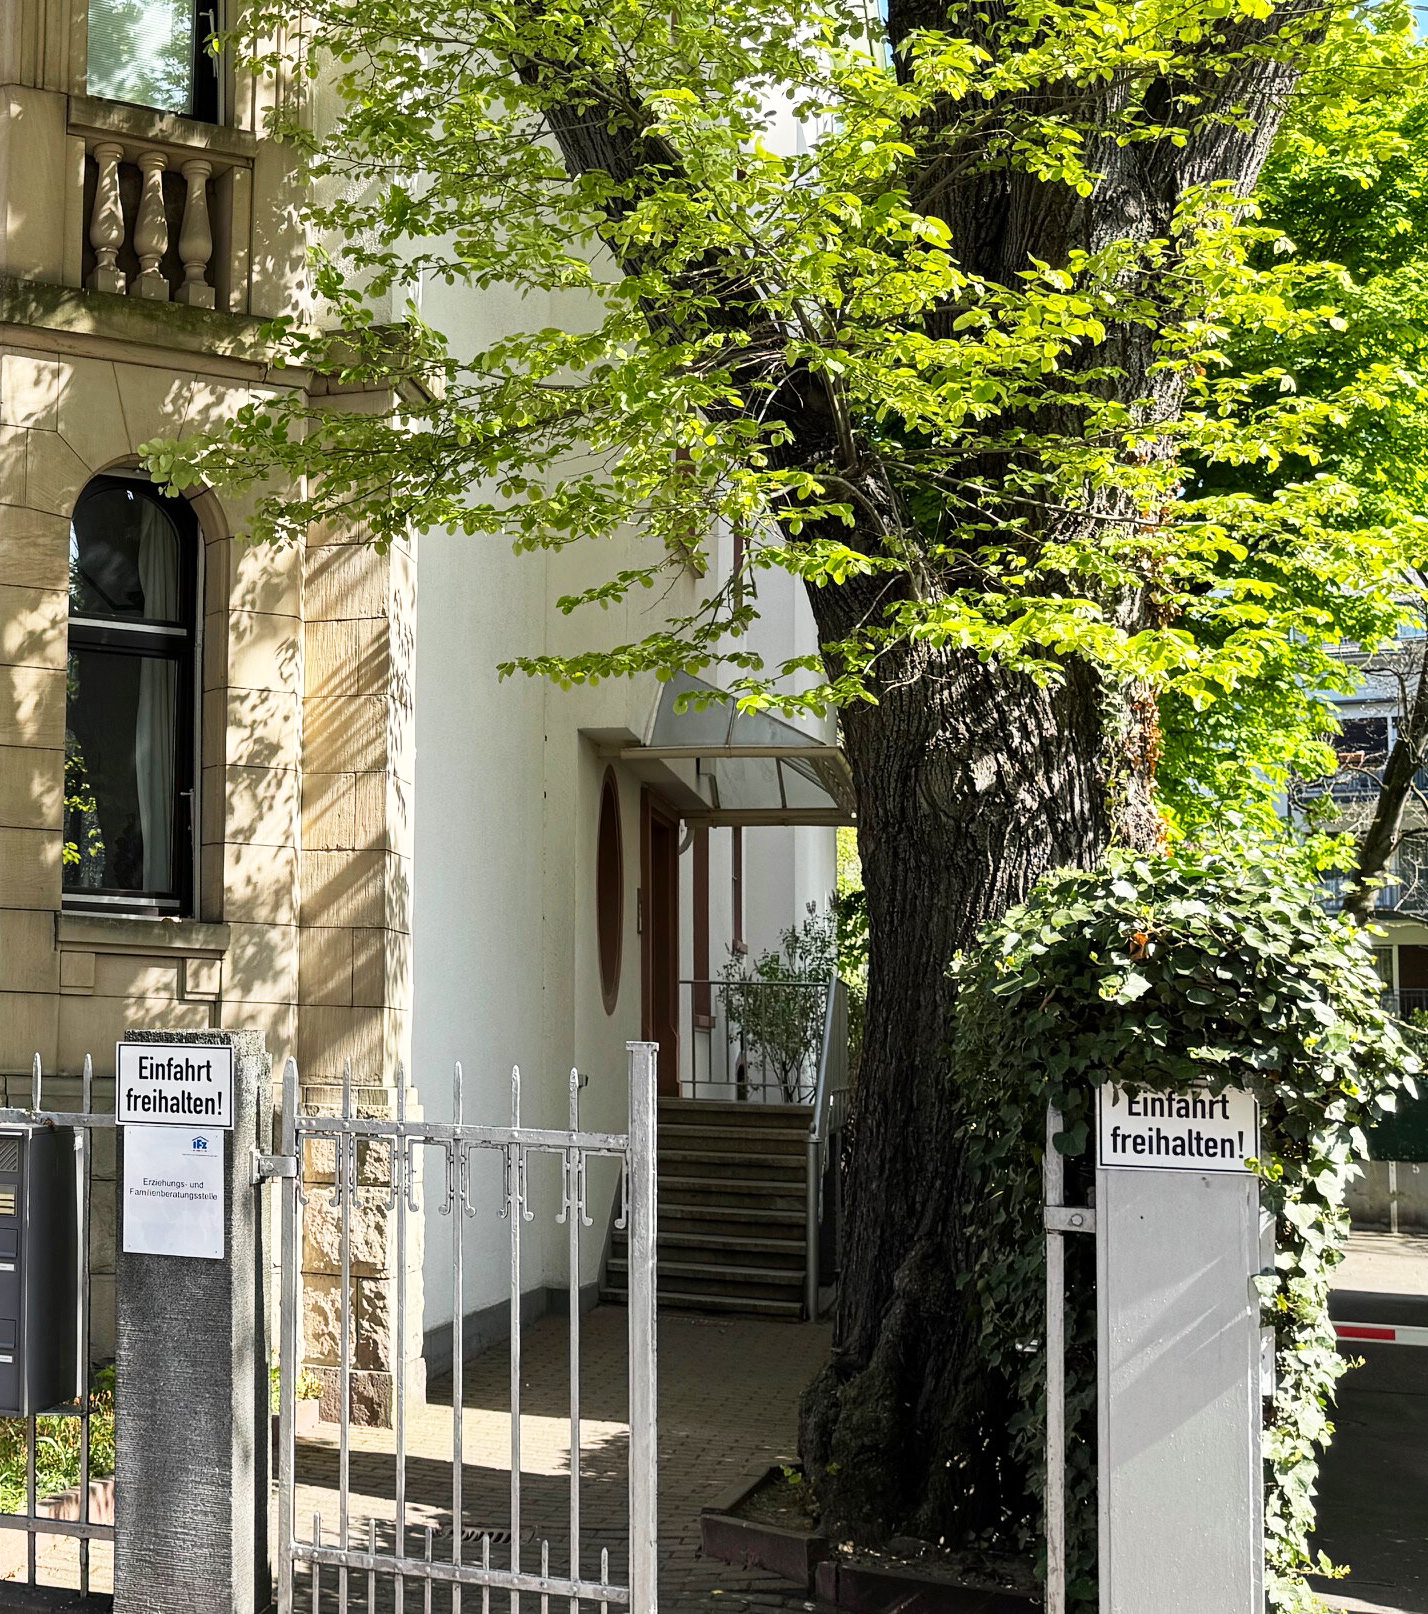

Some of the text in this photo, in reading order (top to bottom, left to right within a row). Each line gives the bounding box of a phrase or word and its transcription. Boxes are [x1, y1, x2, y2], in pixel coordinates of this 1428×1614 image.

[138, 1056, 212, 1082] Einfahrt
[126, 1088, 222, 1115] freihalten!
[1111, 1126, 1244, 1159] freihalten!
[129, 1188, 218, 1201] Familienberatungsstelle
[143, 1178, 204, 1189] Erziehungs- und
